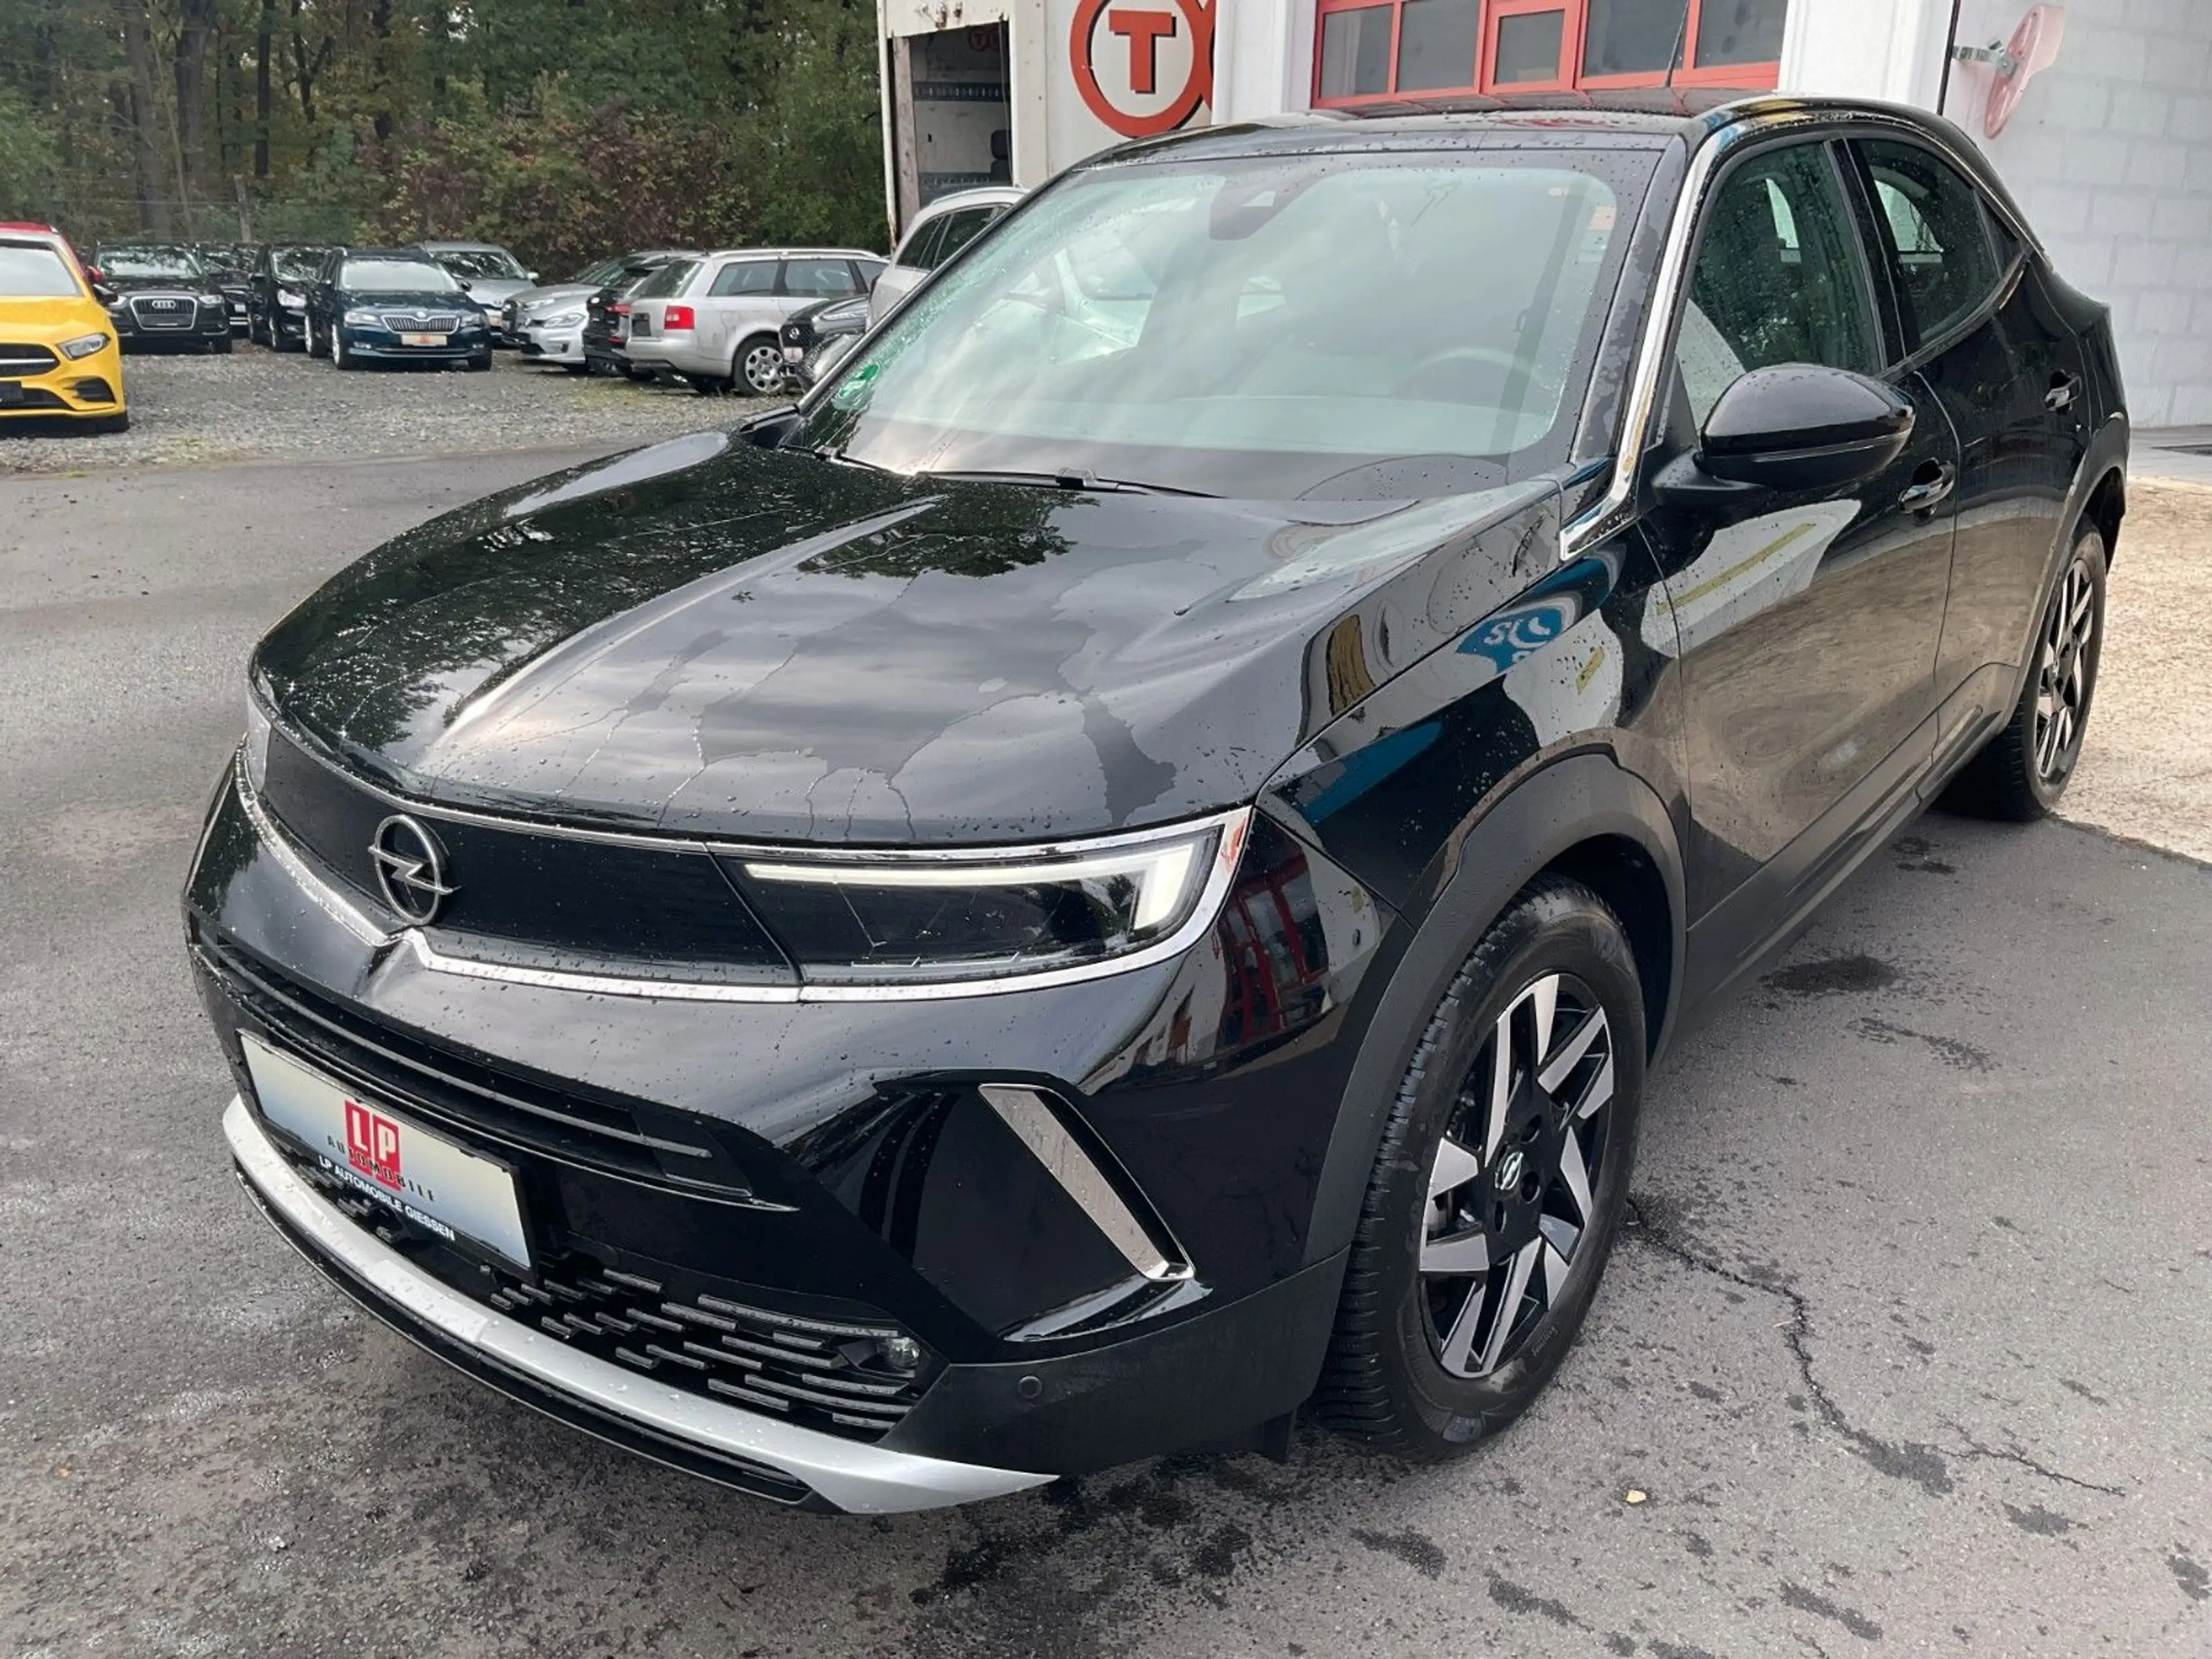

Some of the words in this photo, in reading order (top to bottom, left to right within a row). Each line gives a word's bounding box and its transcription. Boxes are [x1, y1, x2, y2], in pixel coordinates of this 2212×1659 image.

[1109, 10, 1175, 93] T
[352, 1109, 396, 1161] LP
[319, 1155, 333, 1169] LP
[334, 1165, 403, 1213] AUTOMOBILE
[404, 1205, 455, 1241] GIESSEN
